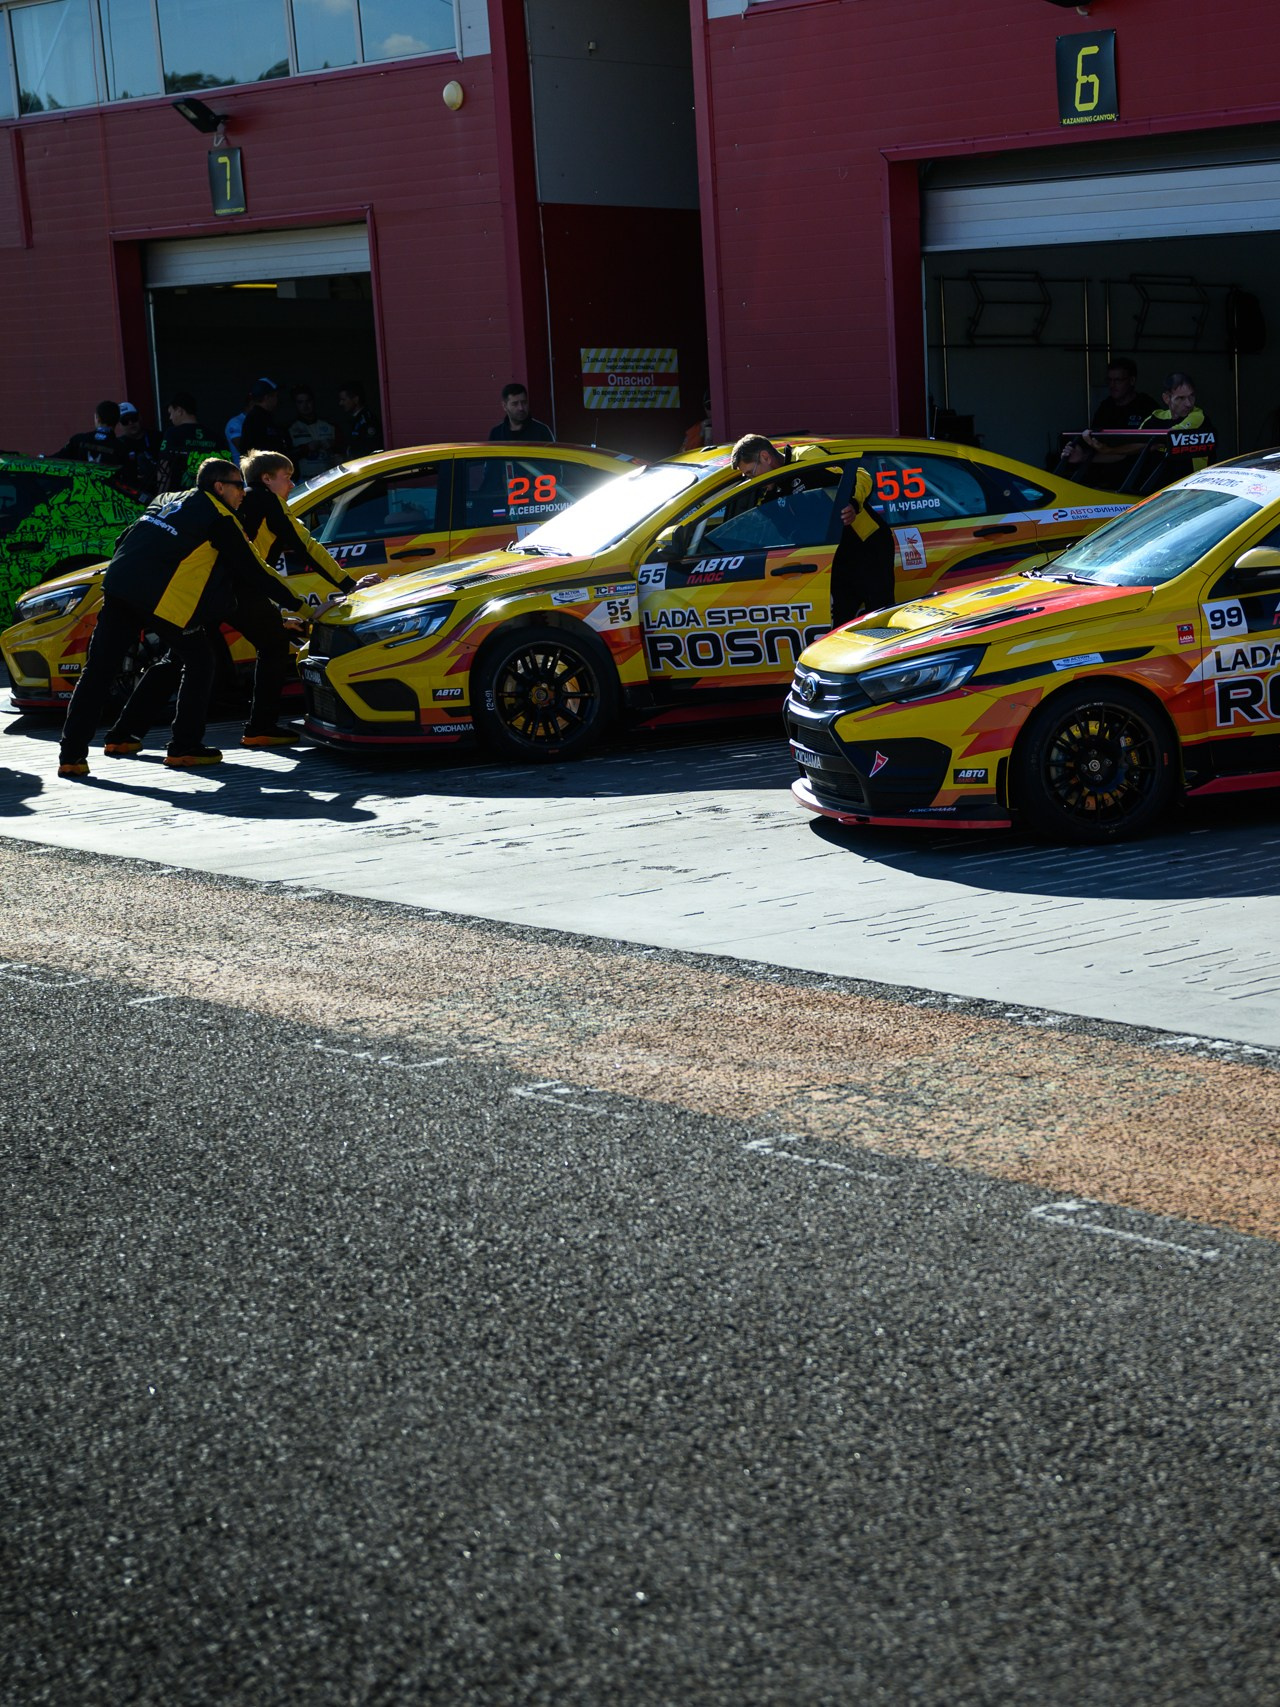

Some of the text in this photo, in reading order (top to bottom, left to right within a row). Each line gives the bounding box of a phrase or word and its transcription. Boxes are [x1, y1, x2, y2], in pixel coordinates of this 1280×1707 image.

[1075, 45, 1100, 112] 6
[1093, 113, 1116, 122] CANYON
[217, 156, 231, 201] 7
[607, 373, 654, 386] Опасно!
[1170, 432, 1216, 446] VESTA
[1170, 443, 1215, 455] SPORT
[507, 474, 557, 505] 28
[875, 467, 926, 501] 55
[889, 498, 941, 513] И.ЧУБАРОВ
[328, 543, 367, 559] ВТО
[690, 555, 745, 575] АВТО
[638, 568, 667, 585] 55
[686, 571, 725, 585] ПЛЮС
[594, 585, 616, 595] TCR
[643, 603, 812, 631] LADA SPORT
[1209, 606, 1243, 630] 99
[60, 663, 80, 671] АВТО
[436, 688, 462, 697] АВТО
[432, 723, 475, 733] YOKOHAMA
[958, 769, 986, 778] АВТО
